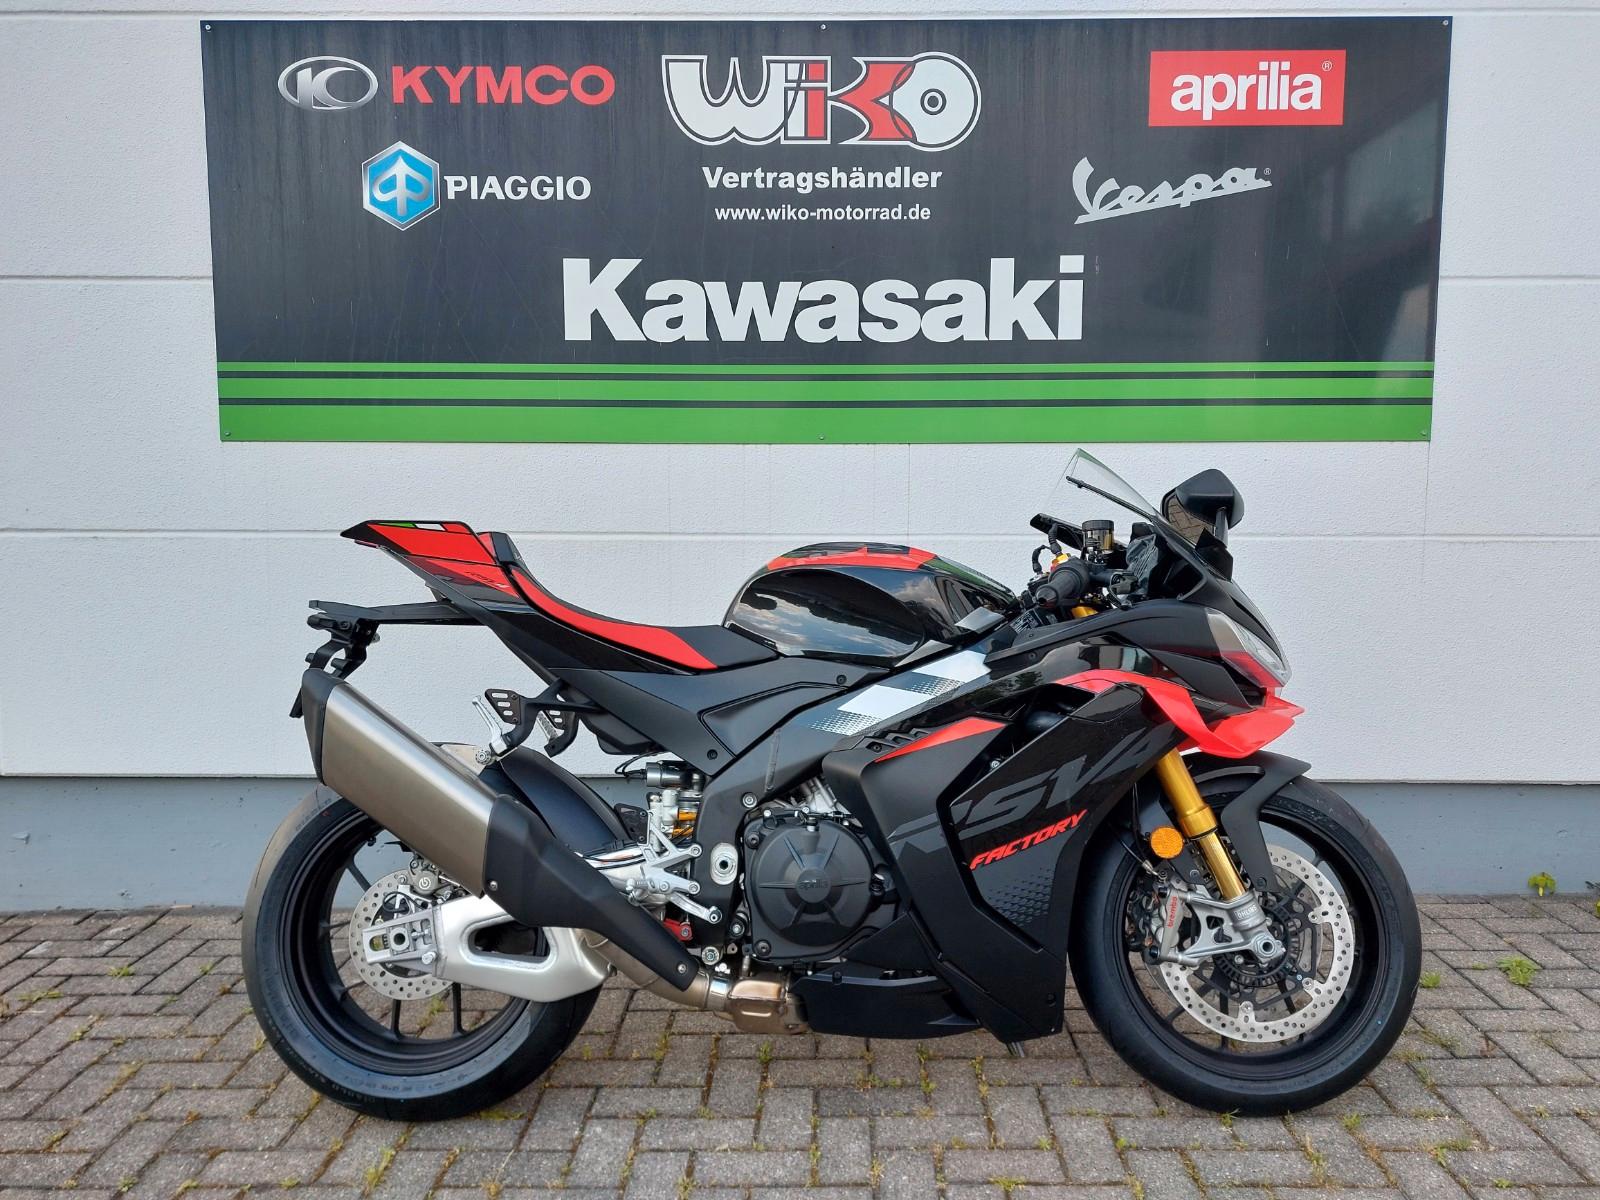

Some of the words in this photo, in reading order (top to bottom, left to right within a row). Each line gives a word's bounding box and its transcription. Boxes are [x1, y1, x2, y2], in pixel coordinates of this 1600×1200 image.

[392, 64, 615, 106] KYMCO
[1170, 61, 1322, 120] aprilia
[444, 175, 592, 200] PIAGGIO
[702, 166, 943, 194] Vertragshändler
[1072, 157, 1273, 225] Vespa
[714, 204, 931, 221] www.wiko-motorrad.de
[562, 254, 1085, 344] Kawasaki
[969, 809, 1088, 870] FACTORY
[1167, 895, 1178, 928] brembo
